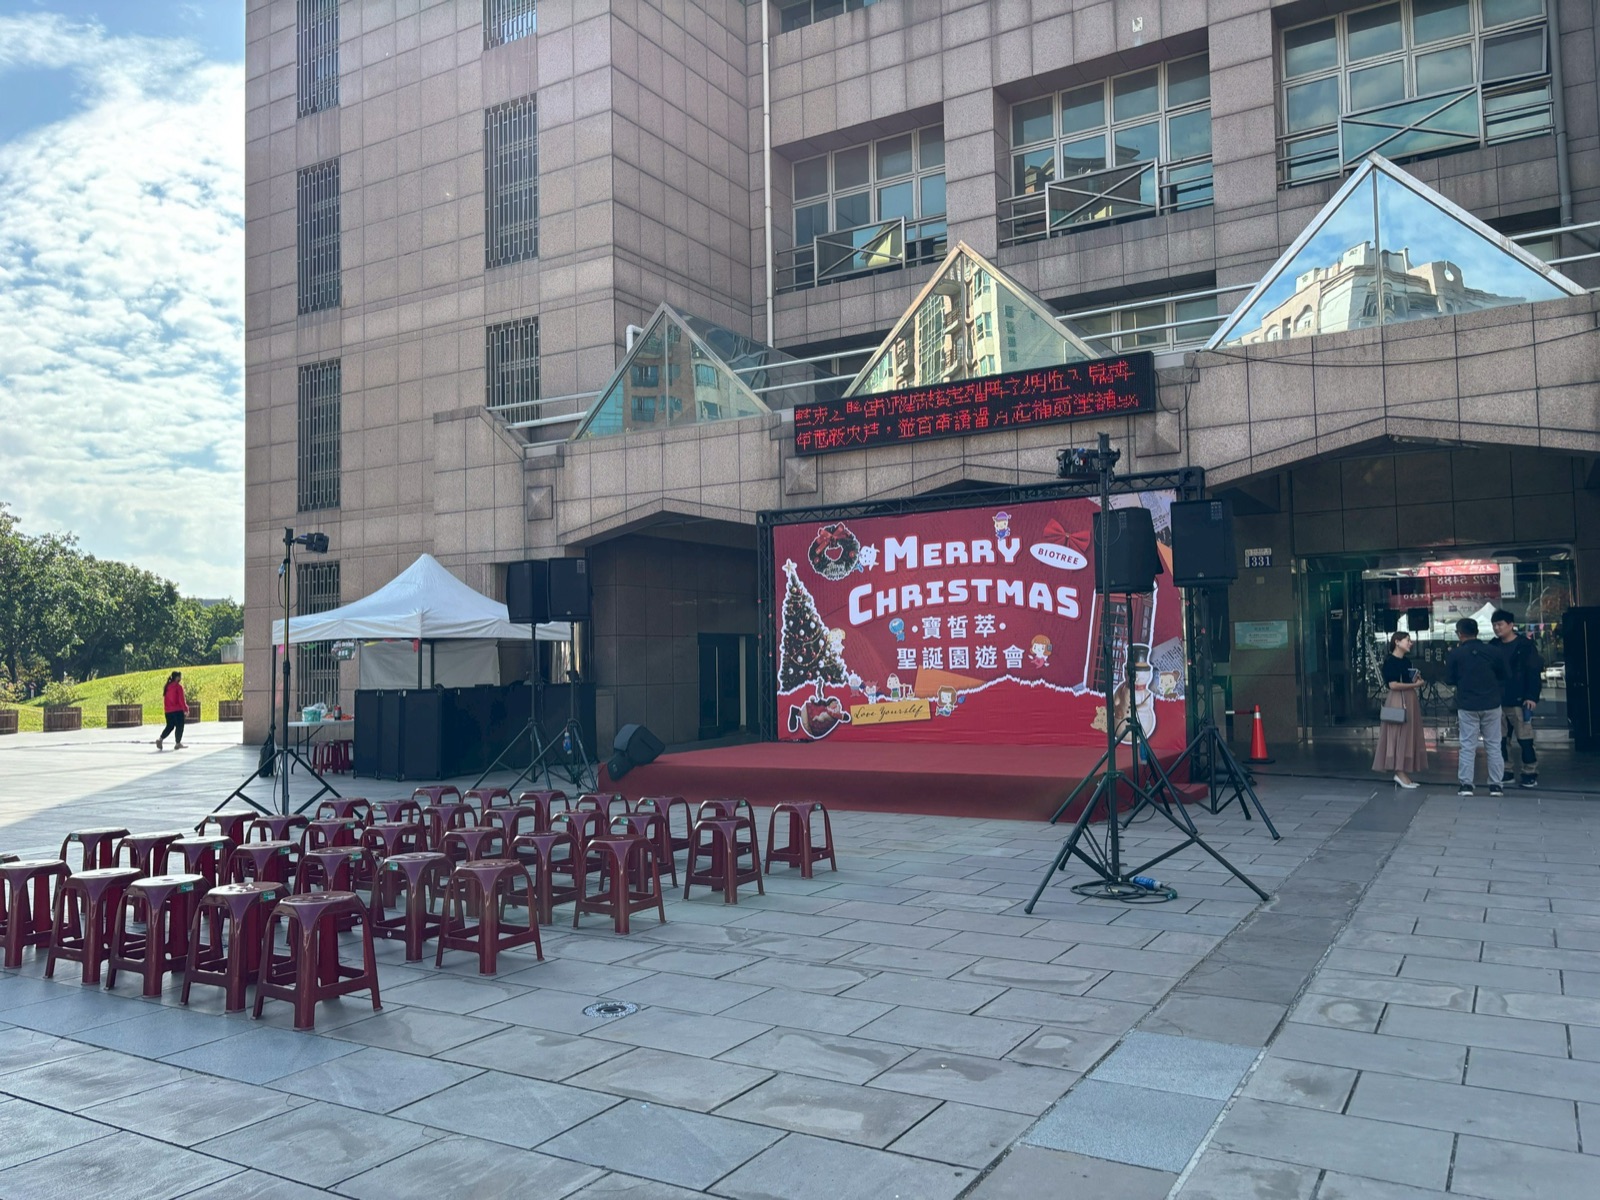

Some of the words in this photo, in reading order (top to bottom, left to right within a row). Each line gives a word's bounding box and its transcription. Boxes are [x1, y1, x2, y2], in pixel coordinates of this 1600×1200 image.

[884, 535, 1021, 573] MERRY
[1038, 547, 1079, 565] BIOTREE
[1251, 556, 1271, 567] 331
[849, 579, 1079, 626] CHRISTMAS
[896, 644, 1025, 670] 聖誕園遊會
[854, 706, 876, 719] Love
